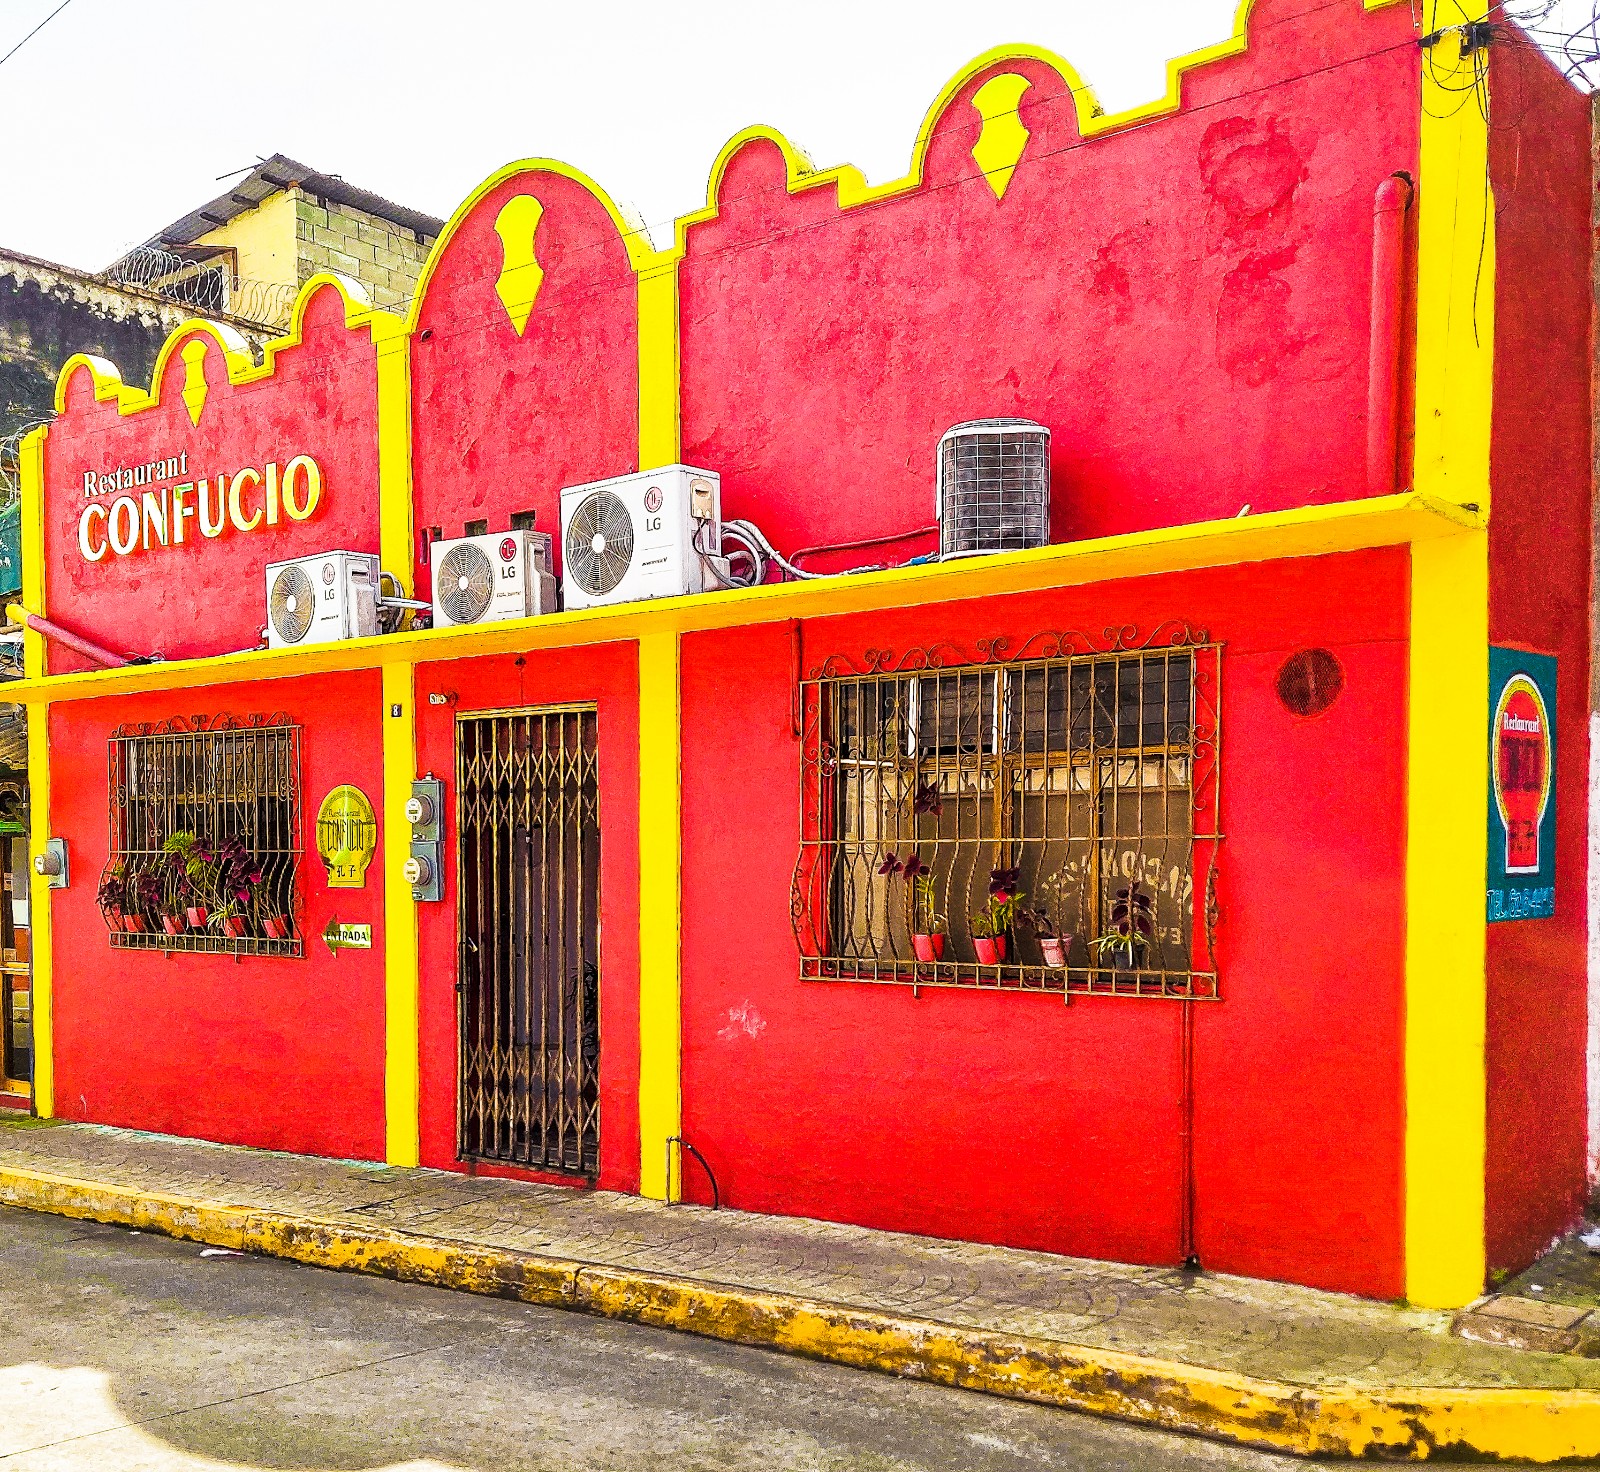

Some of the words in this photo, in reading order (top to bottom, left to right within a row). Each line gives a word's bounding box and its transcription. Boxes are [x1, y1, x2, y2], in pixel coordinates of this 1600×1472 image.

[83, 449, 188, 498] Restaurant
[77, 454, 322, 562] CONFUCIO
[646, 516, 661, 532] LG
[501, 565, 516, 579] LG
[324, 588, 335, 601] LG
[326, 930, 367, 941] ENTRADA
